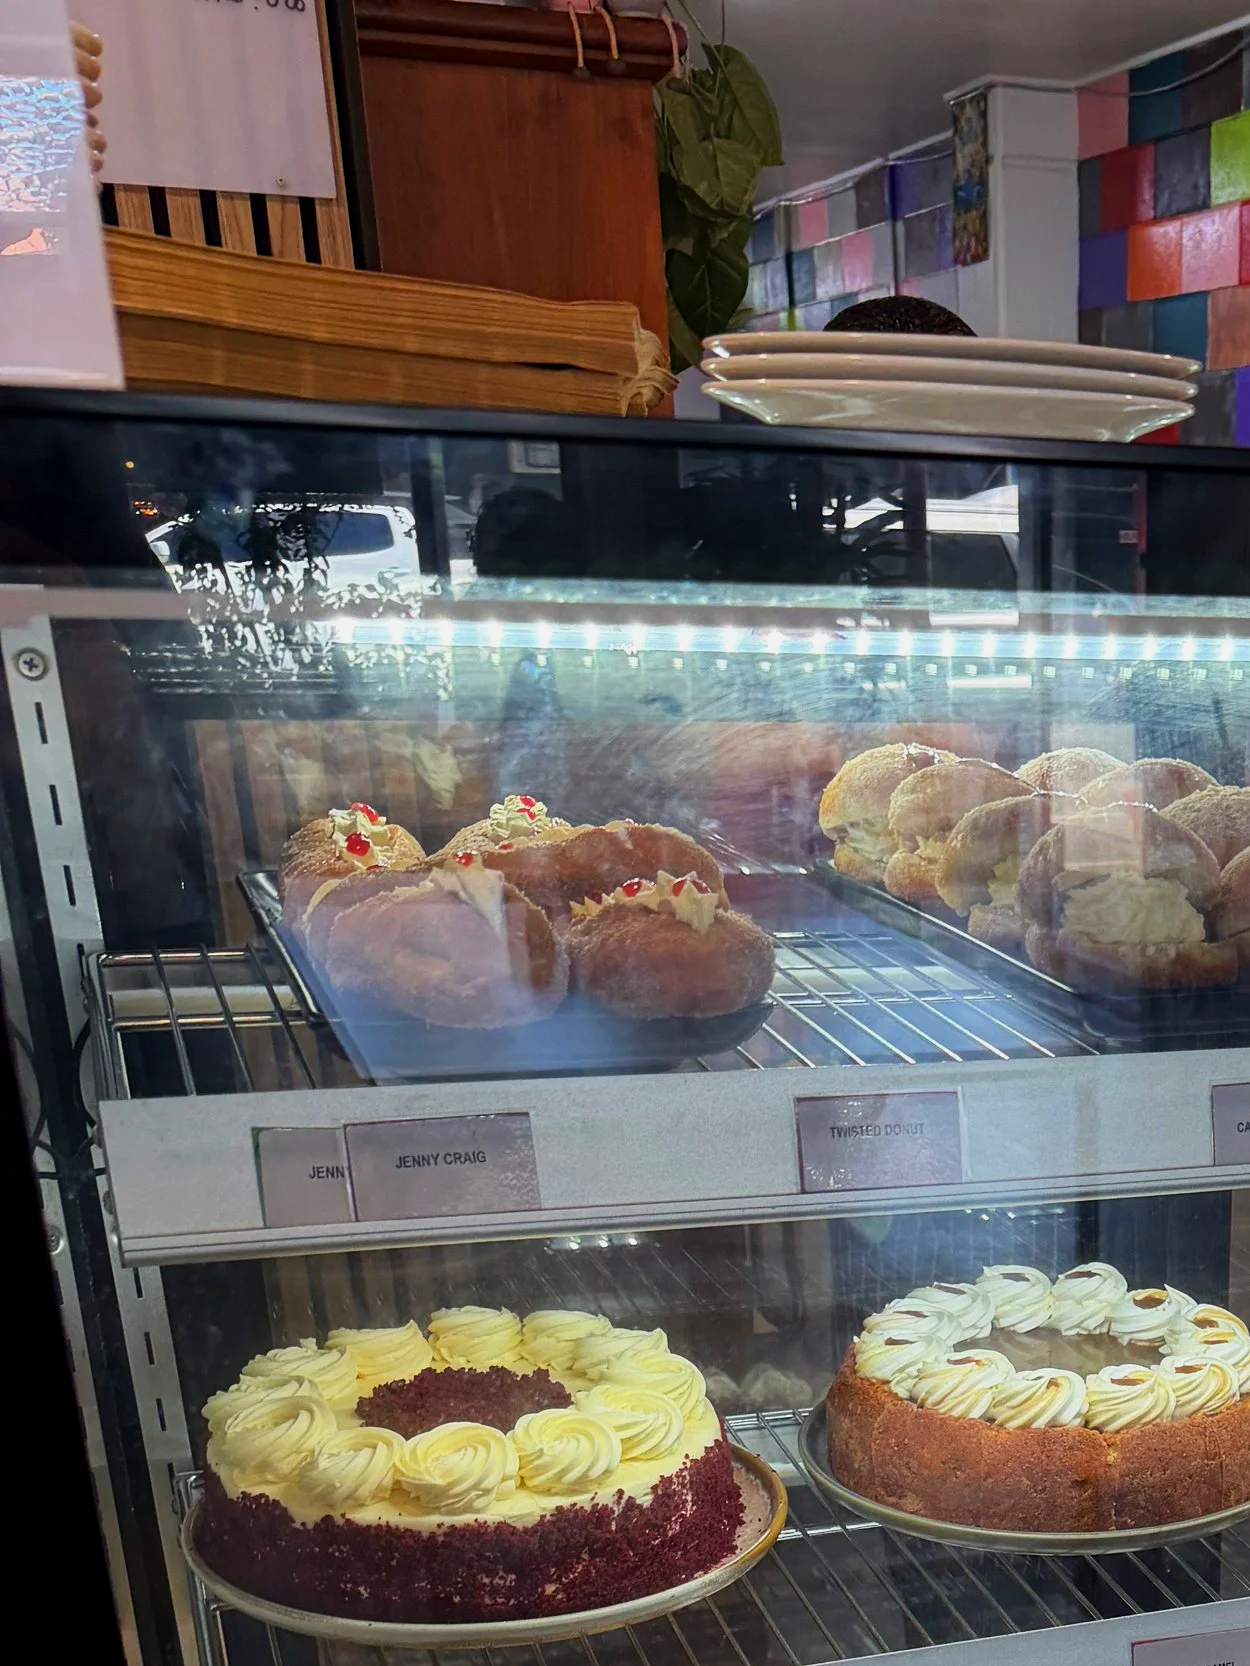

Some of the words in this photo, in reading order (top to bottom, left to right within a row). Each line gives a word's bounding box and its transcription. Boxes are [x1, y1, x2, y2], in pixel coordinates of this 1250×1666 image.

[830, 1125, 881, 1139] TWISTED
[884, 1122, 925, 1137] DONUT
[394, 1153, 440, 1169] JENNY
[443, 1150, 487, 1166] CRAIG
